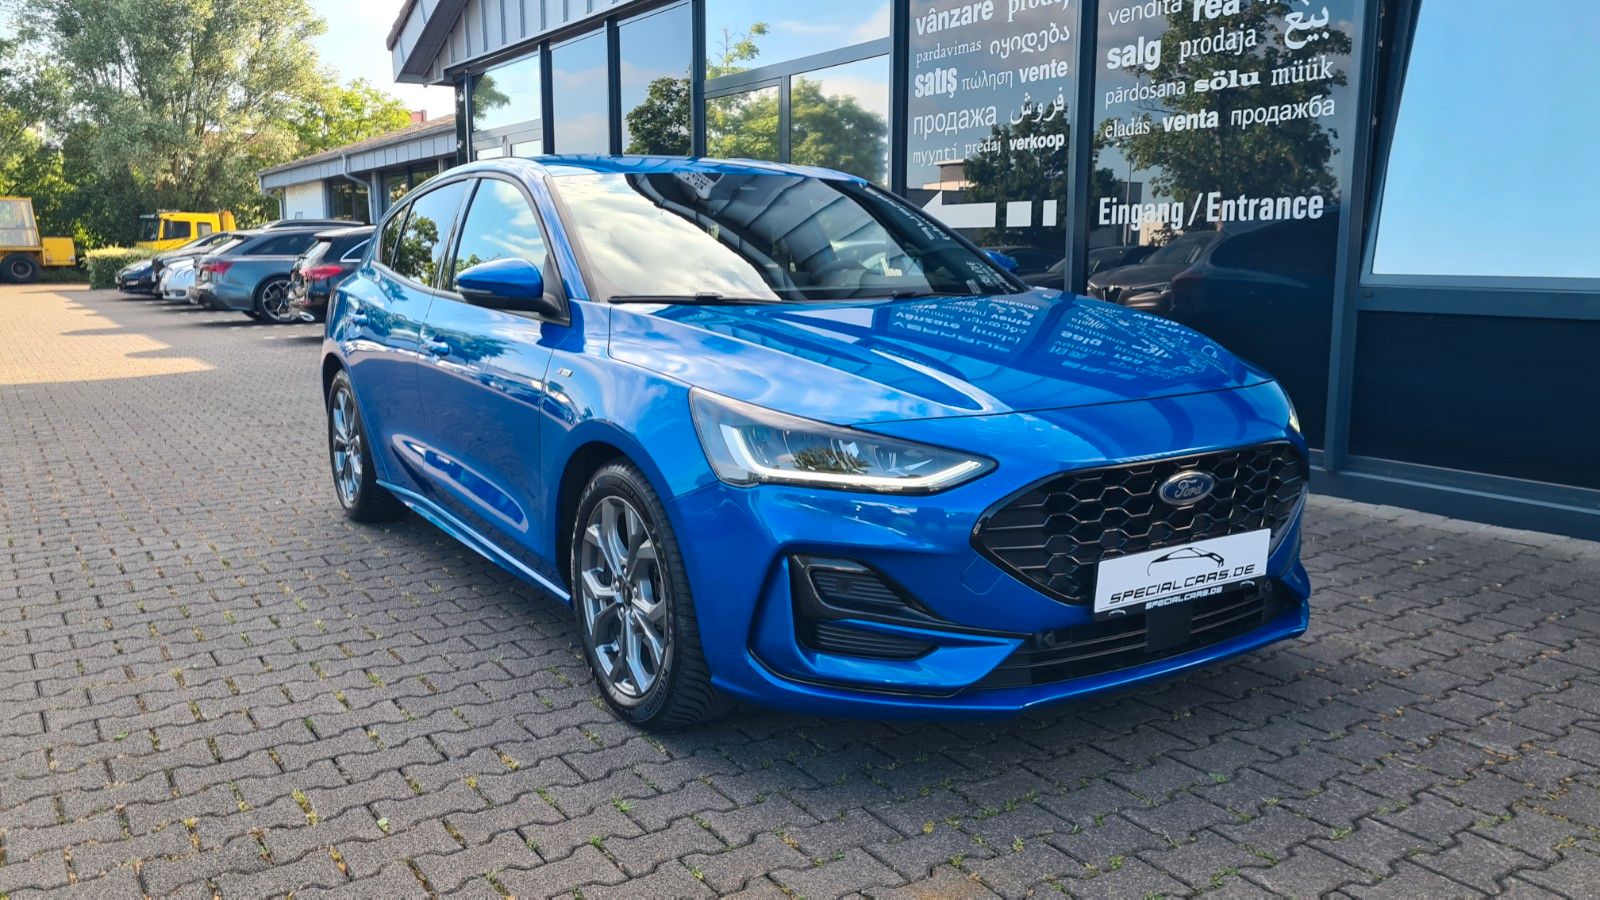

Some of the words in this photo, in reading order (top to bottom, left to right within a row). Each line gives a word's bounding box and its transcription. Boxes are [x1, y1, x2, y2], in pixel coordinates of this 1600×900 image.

[916, 0, 994, 36] vânzare
[916, 39, 982, 68] pardavimas
[1106, 36, 1162, 70] salg
[1179, 23, 1258, 64] prodaja
[914, 67, 958, 98] satış
[961, 69, 1014, 91] πώληση
[1019, 59, 1068, 84] vente
[1105, 79, 1186, 109] pārdošana
[1194, 69, 1261, 93] sölu
[1271, 55, 1334, 87] müük
[913, 105, 998, 139] продажа
[1010, 87, 1066, 125] فروش
[1104, 117, 1151, 139] eladás
[1162, 107, 1219, 133] venta
[1230, 94, 1335, 130] продажба
[913, 144, 958, 167] myynti
[965, 136, 1002, 159] predaj
[1009, 132, 1066, 154] verkoop
[1098, 196, 1184, 232] Eingang
[1206, 191, 1325, 223] Entrance
[1175, 479, 1205, 499] Ford
[1109, 564, 1256, 605] SPECIALCARS.DE
